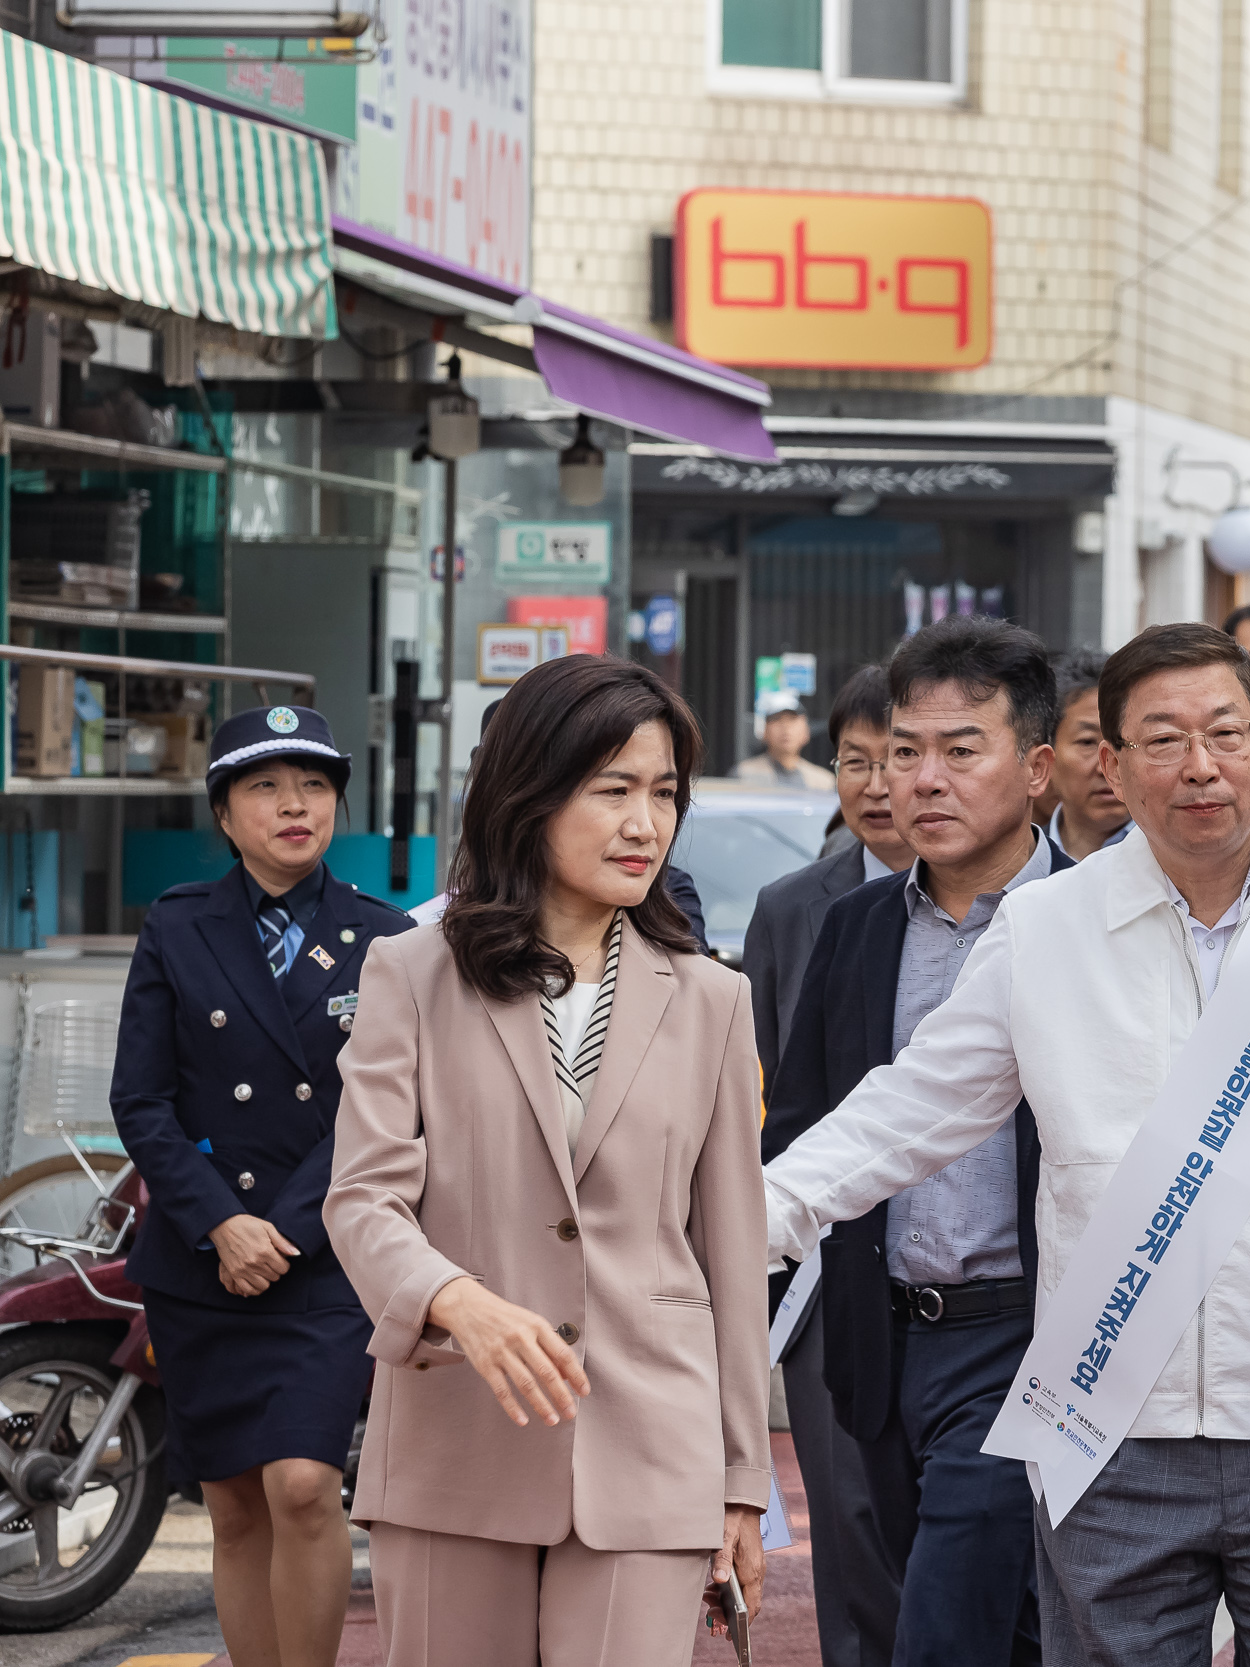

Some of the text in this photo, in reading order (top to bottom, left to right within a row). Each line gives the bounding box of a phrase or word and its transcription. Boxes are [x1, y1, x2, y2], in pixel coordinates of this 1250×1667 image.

[1139, 1152, 1214, 1265] 안전하게
[1070, 1263, 1152, 1395] 지켜주세요
[1075, 1412, 1108, 1442] 서울특별시교육청
